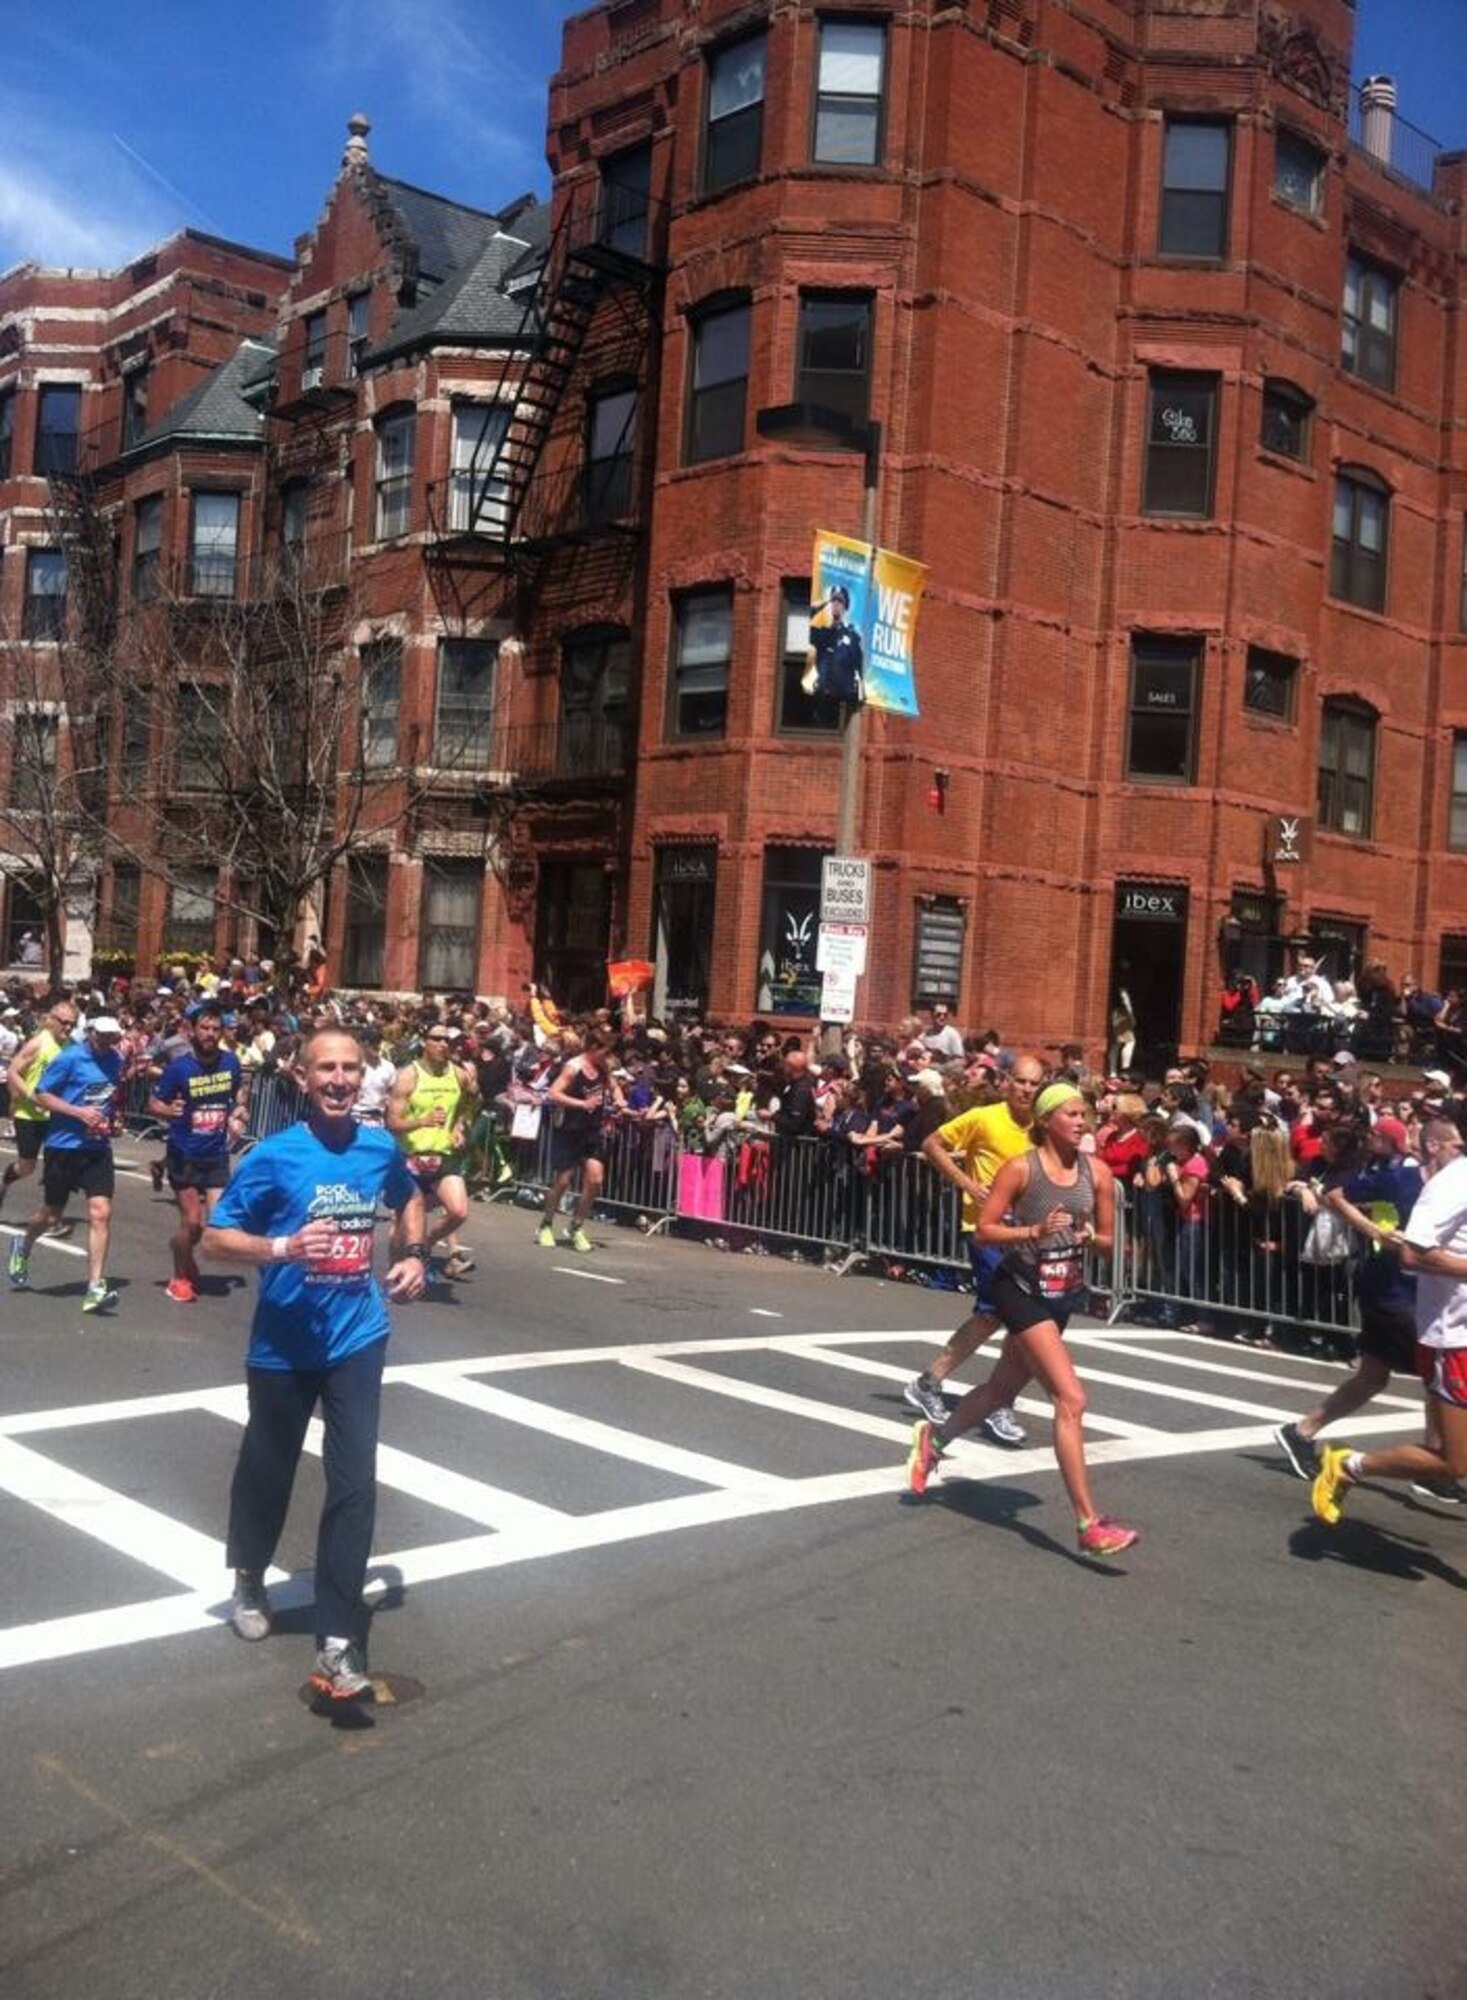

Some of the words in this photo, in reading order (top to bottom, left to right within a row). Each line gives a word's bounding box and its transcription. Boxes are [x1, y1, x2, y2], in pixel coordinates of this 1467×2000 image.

[878, 585, 913, 630] WE
[872, 622, 907, 659] RUN
[828, 862, 866, 878] TRUCKS
[826, 888, 864, 904] BUSES
[823, 905, 863, 918] EXCLUDED
[781, 957, 810, 972] ibex
[315, 1183, 348, 1196] ROCK
